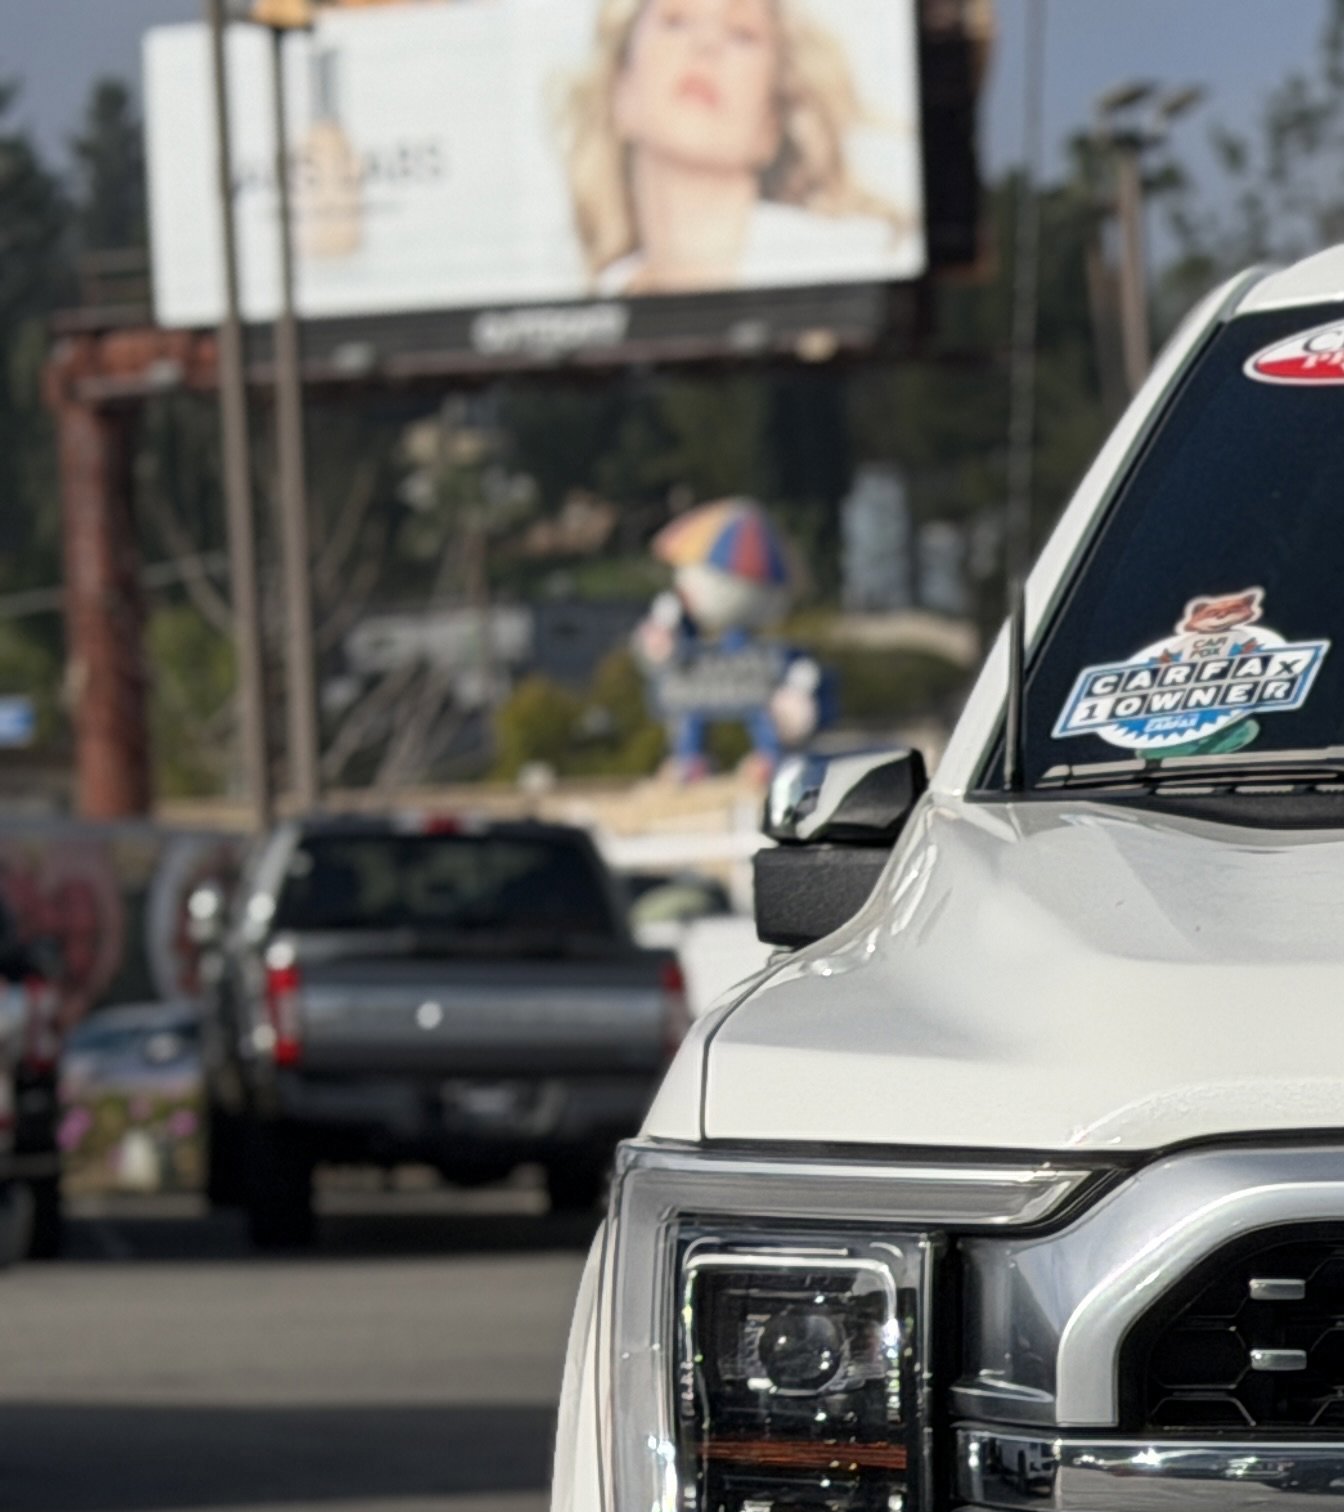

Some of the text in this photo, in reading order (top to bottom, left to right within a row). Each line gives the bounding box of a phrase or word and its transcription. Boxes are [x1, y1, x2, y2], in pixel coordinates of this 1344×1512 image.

[1090, 657, 1302, 695] CARFAX
[1079, 680, 1289, 722] 1 OWNER
